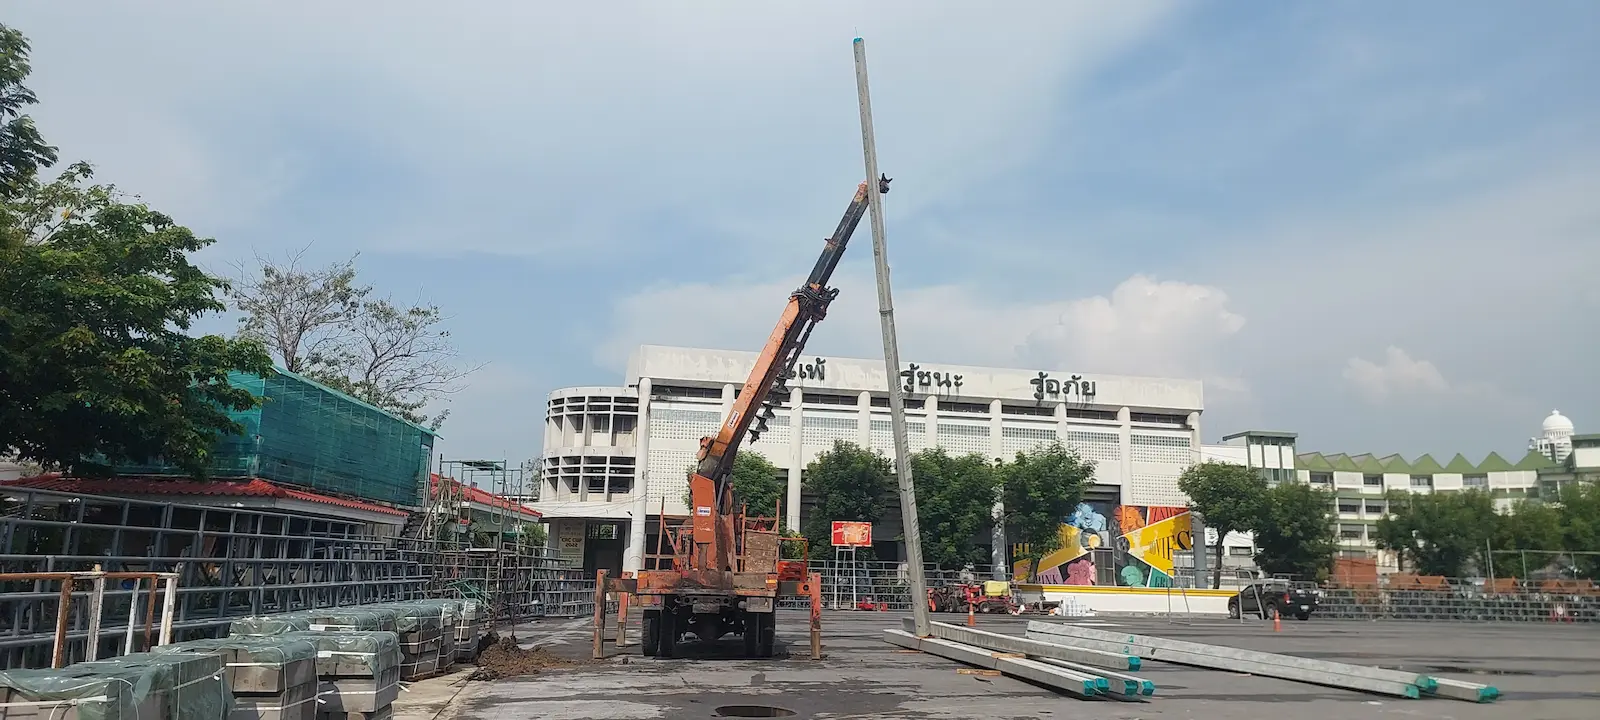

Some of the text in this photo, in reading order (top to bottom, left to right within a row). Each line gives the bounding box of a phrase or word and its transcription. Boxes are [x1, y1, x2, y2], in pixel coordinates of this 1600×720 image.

[900, 358, 963, 392] รู้ชนะ
[1029, 371, 1096, 399] รู้อภัย
